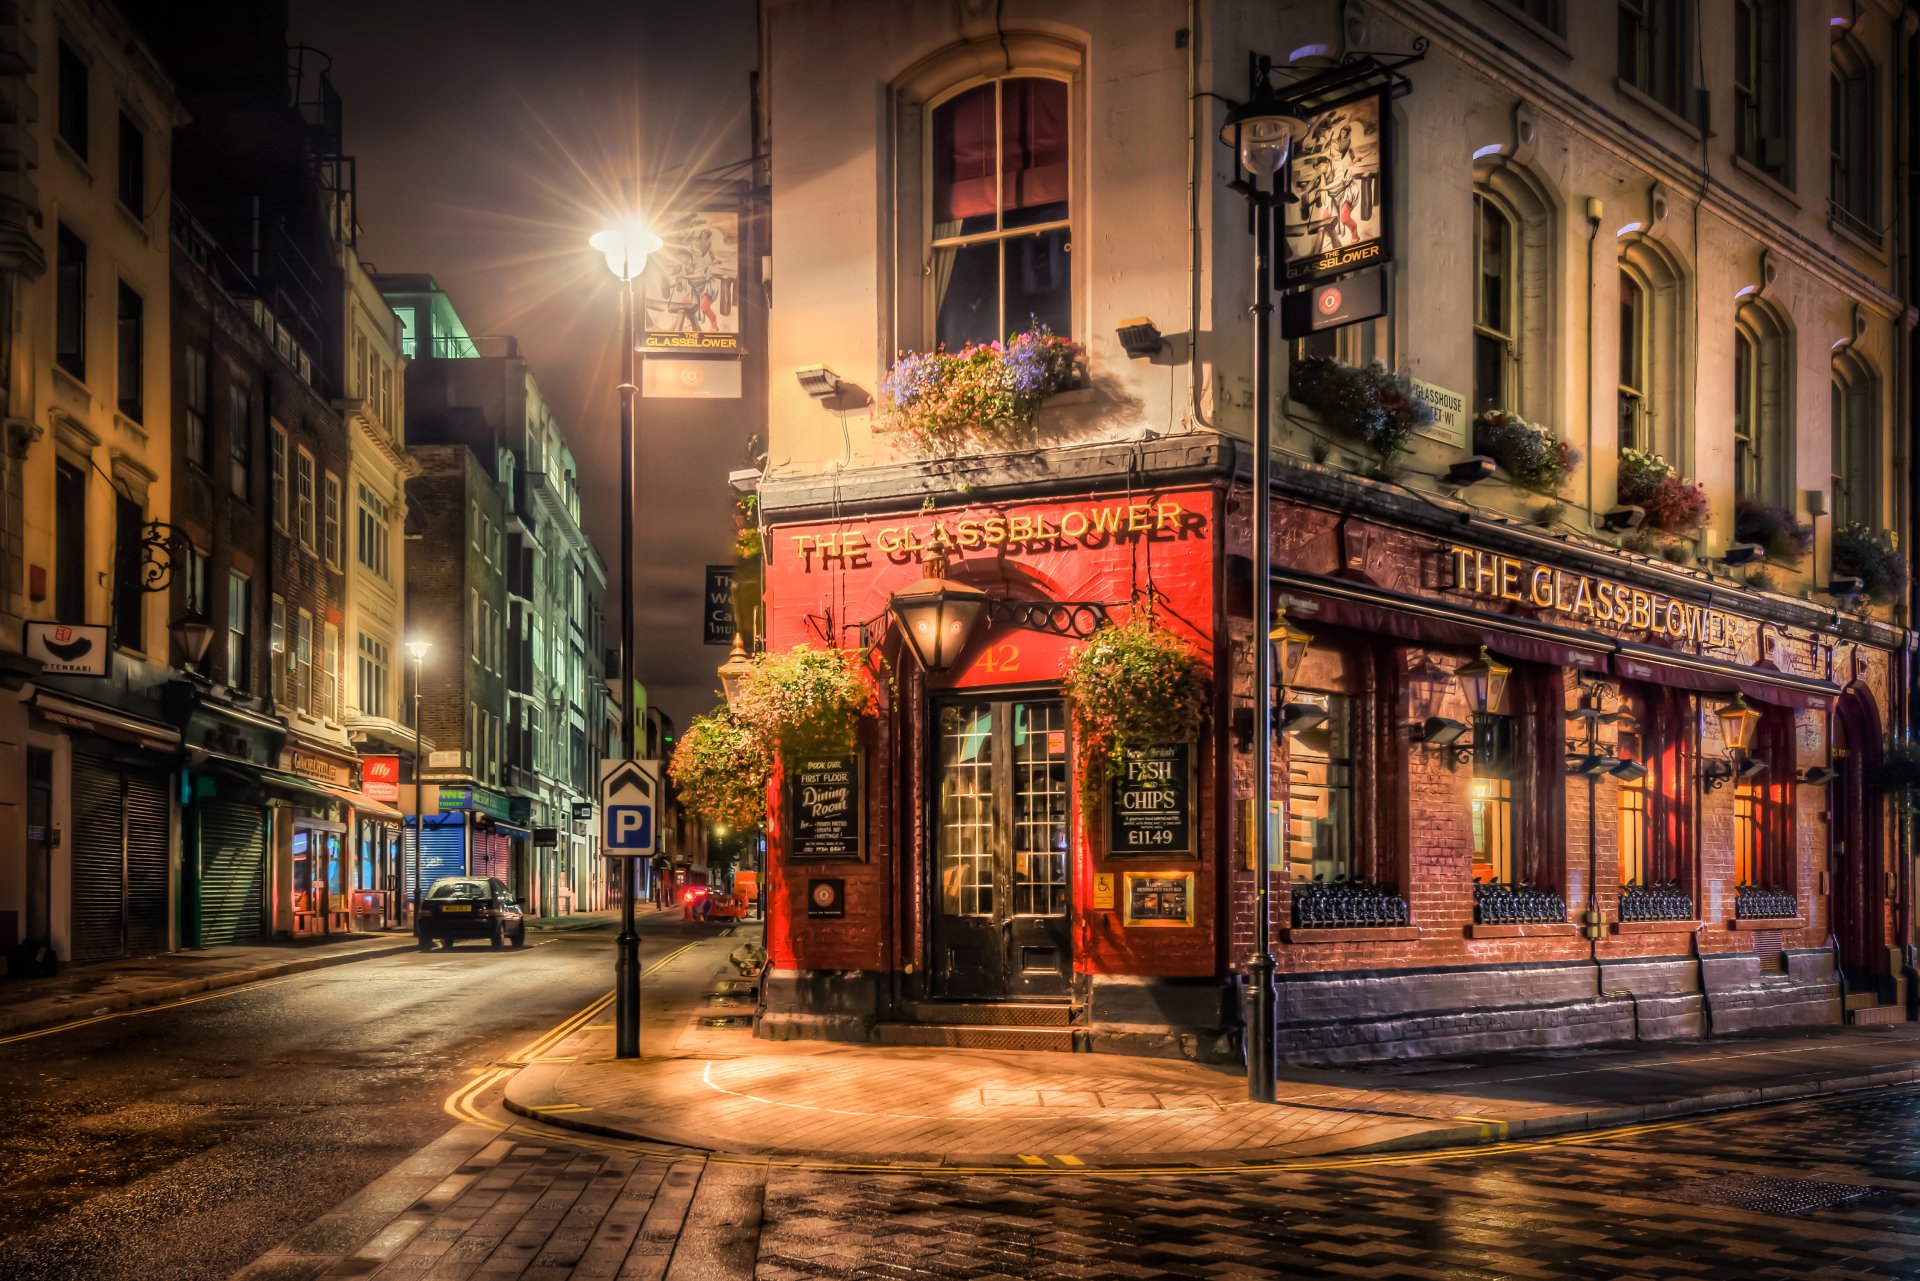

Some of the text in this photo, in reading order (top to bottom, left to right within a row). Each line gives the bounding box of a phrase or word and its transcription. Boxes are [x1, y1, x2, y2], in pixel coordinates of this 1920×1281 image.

[1324, 250, 1340, 259] THE
[646, 337, 737, 348] GLASSBLOWER
[1414, 384, 1462, 413] GLASSHOUSE
[791, 501, 1184, 559] THE GLASSBLOWER
[713, 575, 734, 588] Th
[1451, 545, 1743, 649] THE GLASSBLOWER
[975, 644, 1020, 673] 42
[370, 762, 391, 779] illy
[807, 761, 842, 770] BOOK OUR
[801, 773, 848, 783] FIRST FLOOR
[801, 786, 849, 807] Dining
[1123, 790, 1176, 809] CHIPS
[812, 800, 848, 817] Room
[616, 809, 643, 844] P
[1128, 830, 1173, 845] £11.49
